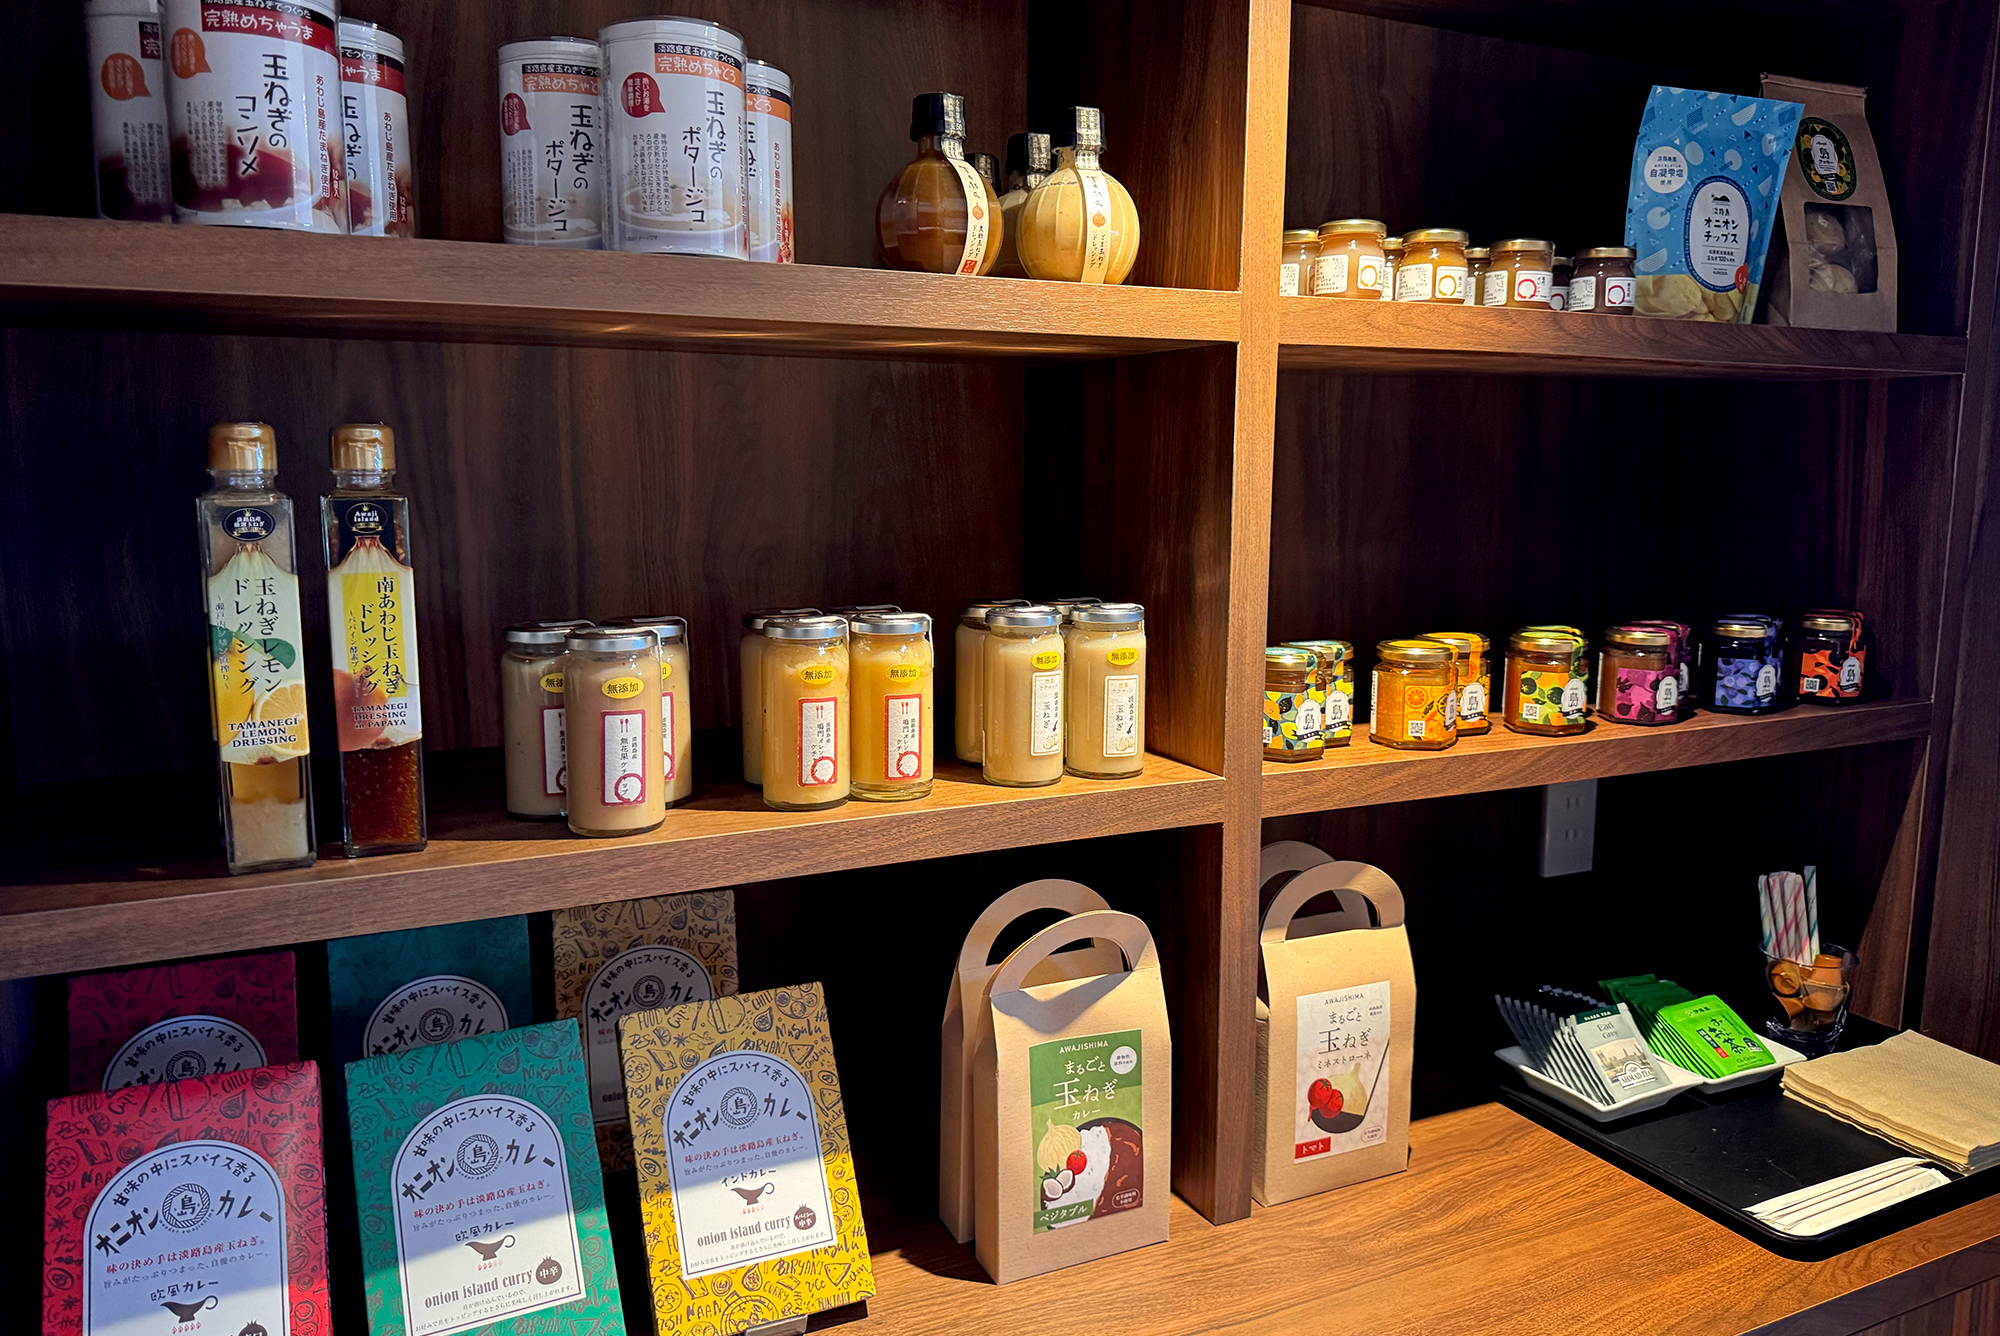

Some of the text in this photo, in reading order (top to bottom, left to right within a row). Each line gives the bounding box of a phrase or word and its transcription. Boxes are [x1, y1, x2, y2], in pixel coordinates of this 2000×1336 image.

[204, 9, 313, 40] 完熟めちゃうま
[658, 56, 736, 83] 完熟めちゃとろ
[262, 54, 292, 148] 玉ねぎの
[235, 95, 258, 176] コンソメ
[570, 105, 595, 190] 玉ねぎの
[706, 91, 727, 180] 玉ねぎの
[1704, 217, 1739, 230] オニオン
[1704, 231, 1738, 244] チップス
[234, 578, 259, 695] ドレッシング
[255, 577, 282, 692] 玉ねぎレモン
[377, 577, 402, 694] 南あわじ玉ねぎ
[361, 604, 381, 694] ドレッシング
[1035, 655, 1058, 665] 無添加
[1111, 652, 1135, 661] 無添加
[804, 669, 832, 680] 無添加
[889, 668, 916, 678] 無添加
[607, 682, 639, 694] 無添加
[352, 703, 408, 713] TAMANEGI
[354, 711, 406, 721] DRESSING
[1043, 701, 1051, 729] 玉ねぎ
[1115, 705, 1124, 731] 玉ねぎ
[228, 718, 298, 731] TAMANEGI
[241, 727, 287, 738] LEMON
[369, 719, 406, 728] PAPAYA
[232, 734, 297, 748] DRESSING
[600, 954, 695, 989] 甘味の中にスパイス香る
[383, 985, 486, 1024] 甘味の中にスパイス香る
[591, 990, 631, 1023] オニオン
[1324, 992, 1364, 1005] AWAJISHIMA
[1328, 1007, 1362, 1025] まるごと
[1596, 1021, 1615, 1031] Earl
[125, 1026, 245, 1069] 甘味の中にスパイス香る
[1059, 1040, 1109, 1054] AWAJISHIMA
[1318, 1027, 1372, 1055] 玉ねぎ
[1602, 1031, 1619, 1039] Grey
[1064, 1056, 1106, 1075] まるごと
[1317, 1050, 1371, 1069] ミネストローネ
[682, 1061, 790, 1107] 甘味の中にスパイス香る
[1620, 1072, 1642, 1084] AHMAD
[1053, 1077, 1118, 1110] 玉ねぎ
[673, 1107, 720, 1149] オニオン
[763, 1092, 808, 1122] カレー
[1072, 1108, 1101, 1120] カレー
[413, 1106, 537, 1158] 甘味の中にスパイス香る
[684, 1132, 804, 1164] 味の決め手は淡路島産玉ねぎ。
[684, 1145, 808, 1176] 旨みがたっぷりつまった、自慢のカレー。
[1302, 1142, 1325, 1155] トマト
[112, 1153, 257, 1207] 甘味の中にスパイス香る
[401, 1157, 455, 1203] オニオン
[505, 1138, 556, 1168] カレー
[720, 1168, 777, 1188] インドカレー
[414, 1179, 550, 1218] 味の決め手は淡路島産玉ねぎ。
[95, 1207, 159, 1257] オニオン
[216, 1189, 273, 1224] カレー
[413, 1193, 555, 1232] 旨みがたっぷりつまった、自慢のカレー。
[455, 1220, 514, 1242] 欧風カレー
[697, 1213, 791, 1248] onion island curry
[106, 1236, 264, 1274] 味の決め手は淡路島産玉ねぎ。
[772, 1258, 824, 1276] BIRYANI
[104, 1250, 269, 1289] 旨みがたっぷりつまった、自慢のカレー。
[540, 1264, 559, 1279] 中辛
[151, 1280, 219, 1301] 欧風カレー
[424, 1268, 533, 1308] onion island curry
[763, 1281, 788, 1301] CURRY
